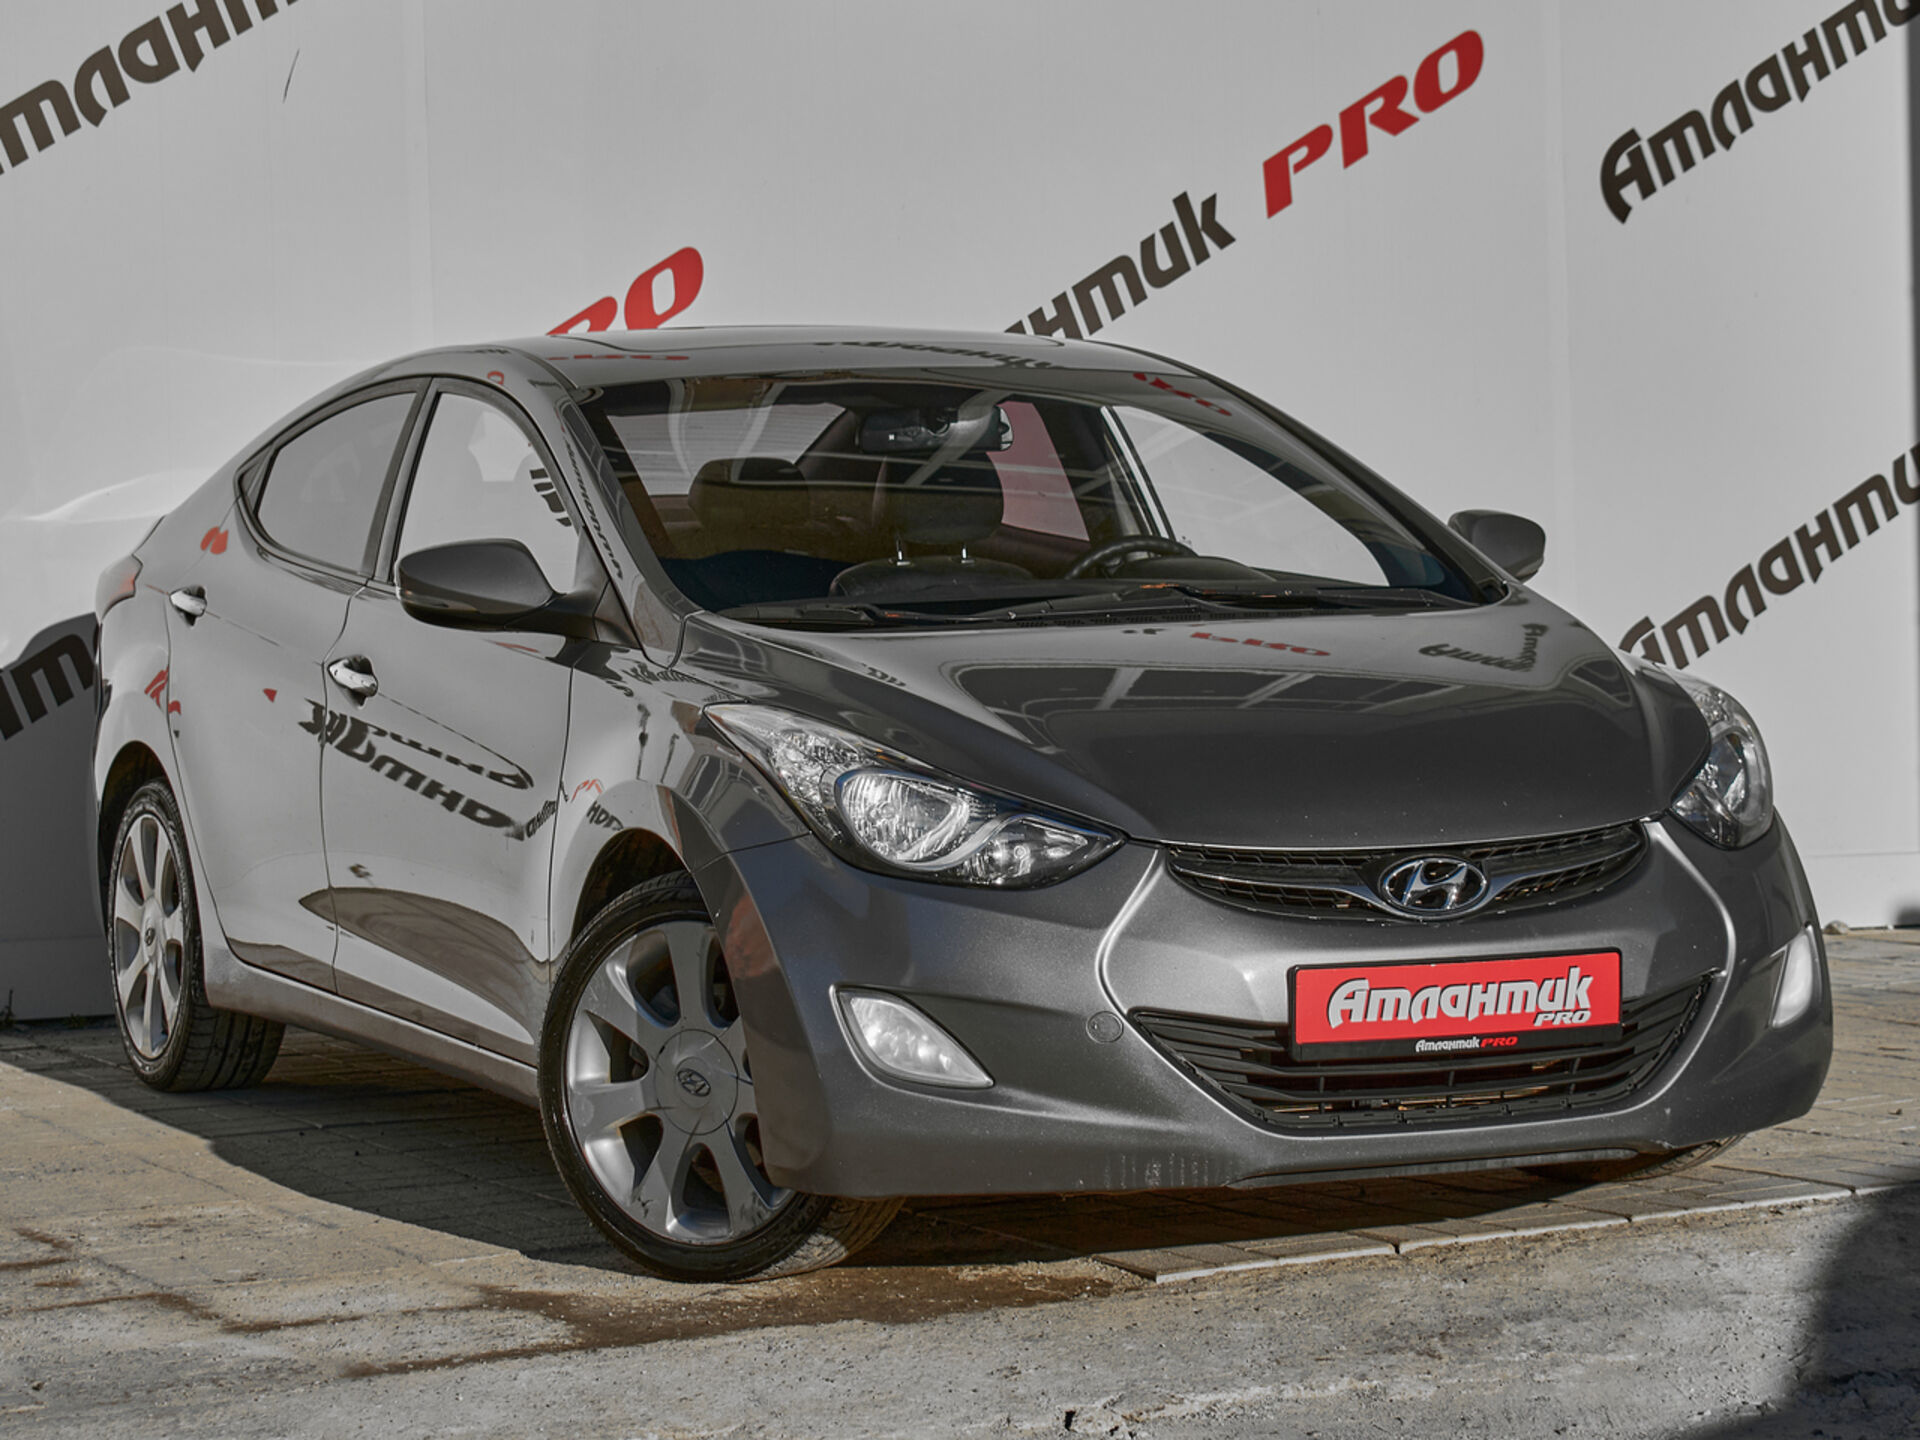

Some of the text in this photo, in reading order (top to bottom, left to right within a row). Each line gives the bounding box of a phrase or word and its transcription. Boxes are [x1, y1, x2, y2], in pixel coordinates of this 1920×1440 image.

[1004, 30, 1484, 340] нтик PRO
[1327, 966, 1594, 1029] Атлантик
[1533, 1010, 1592, 1027] PRO
[1415, 1036, 1518, 1053] Атлантик PRO
